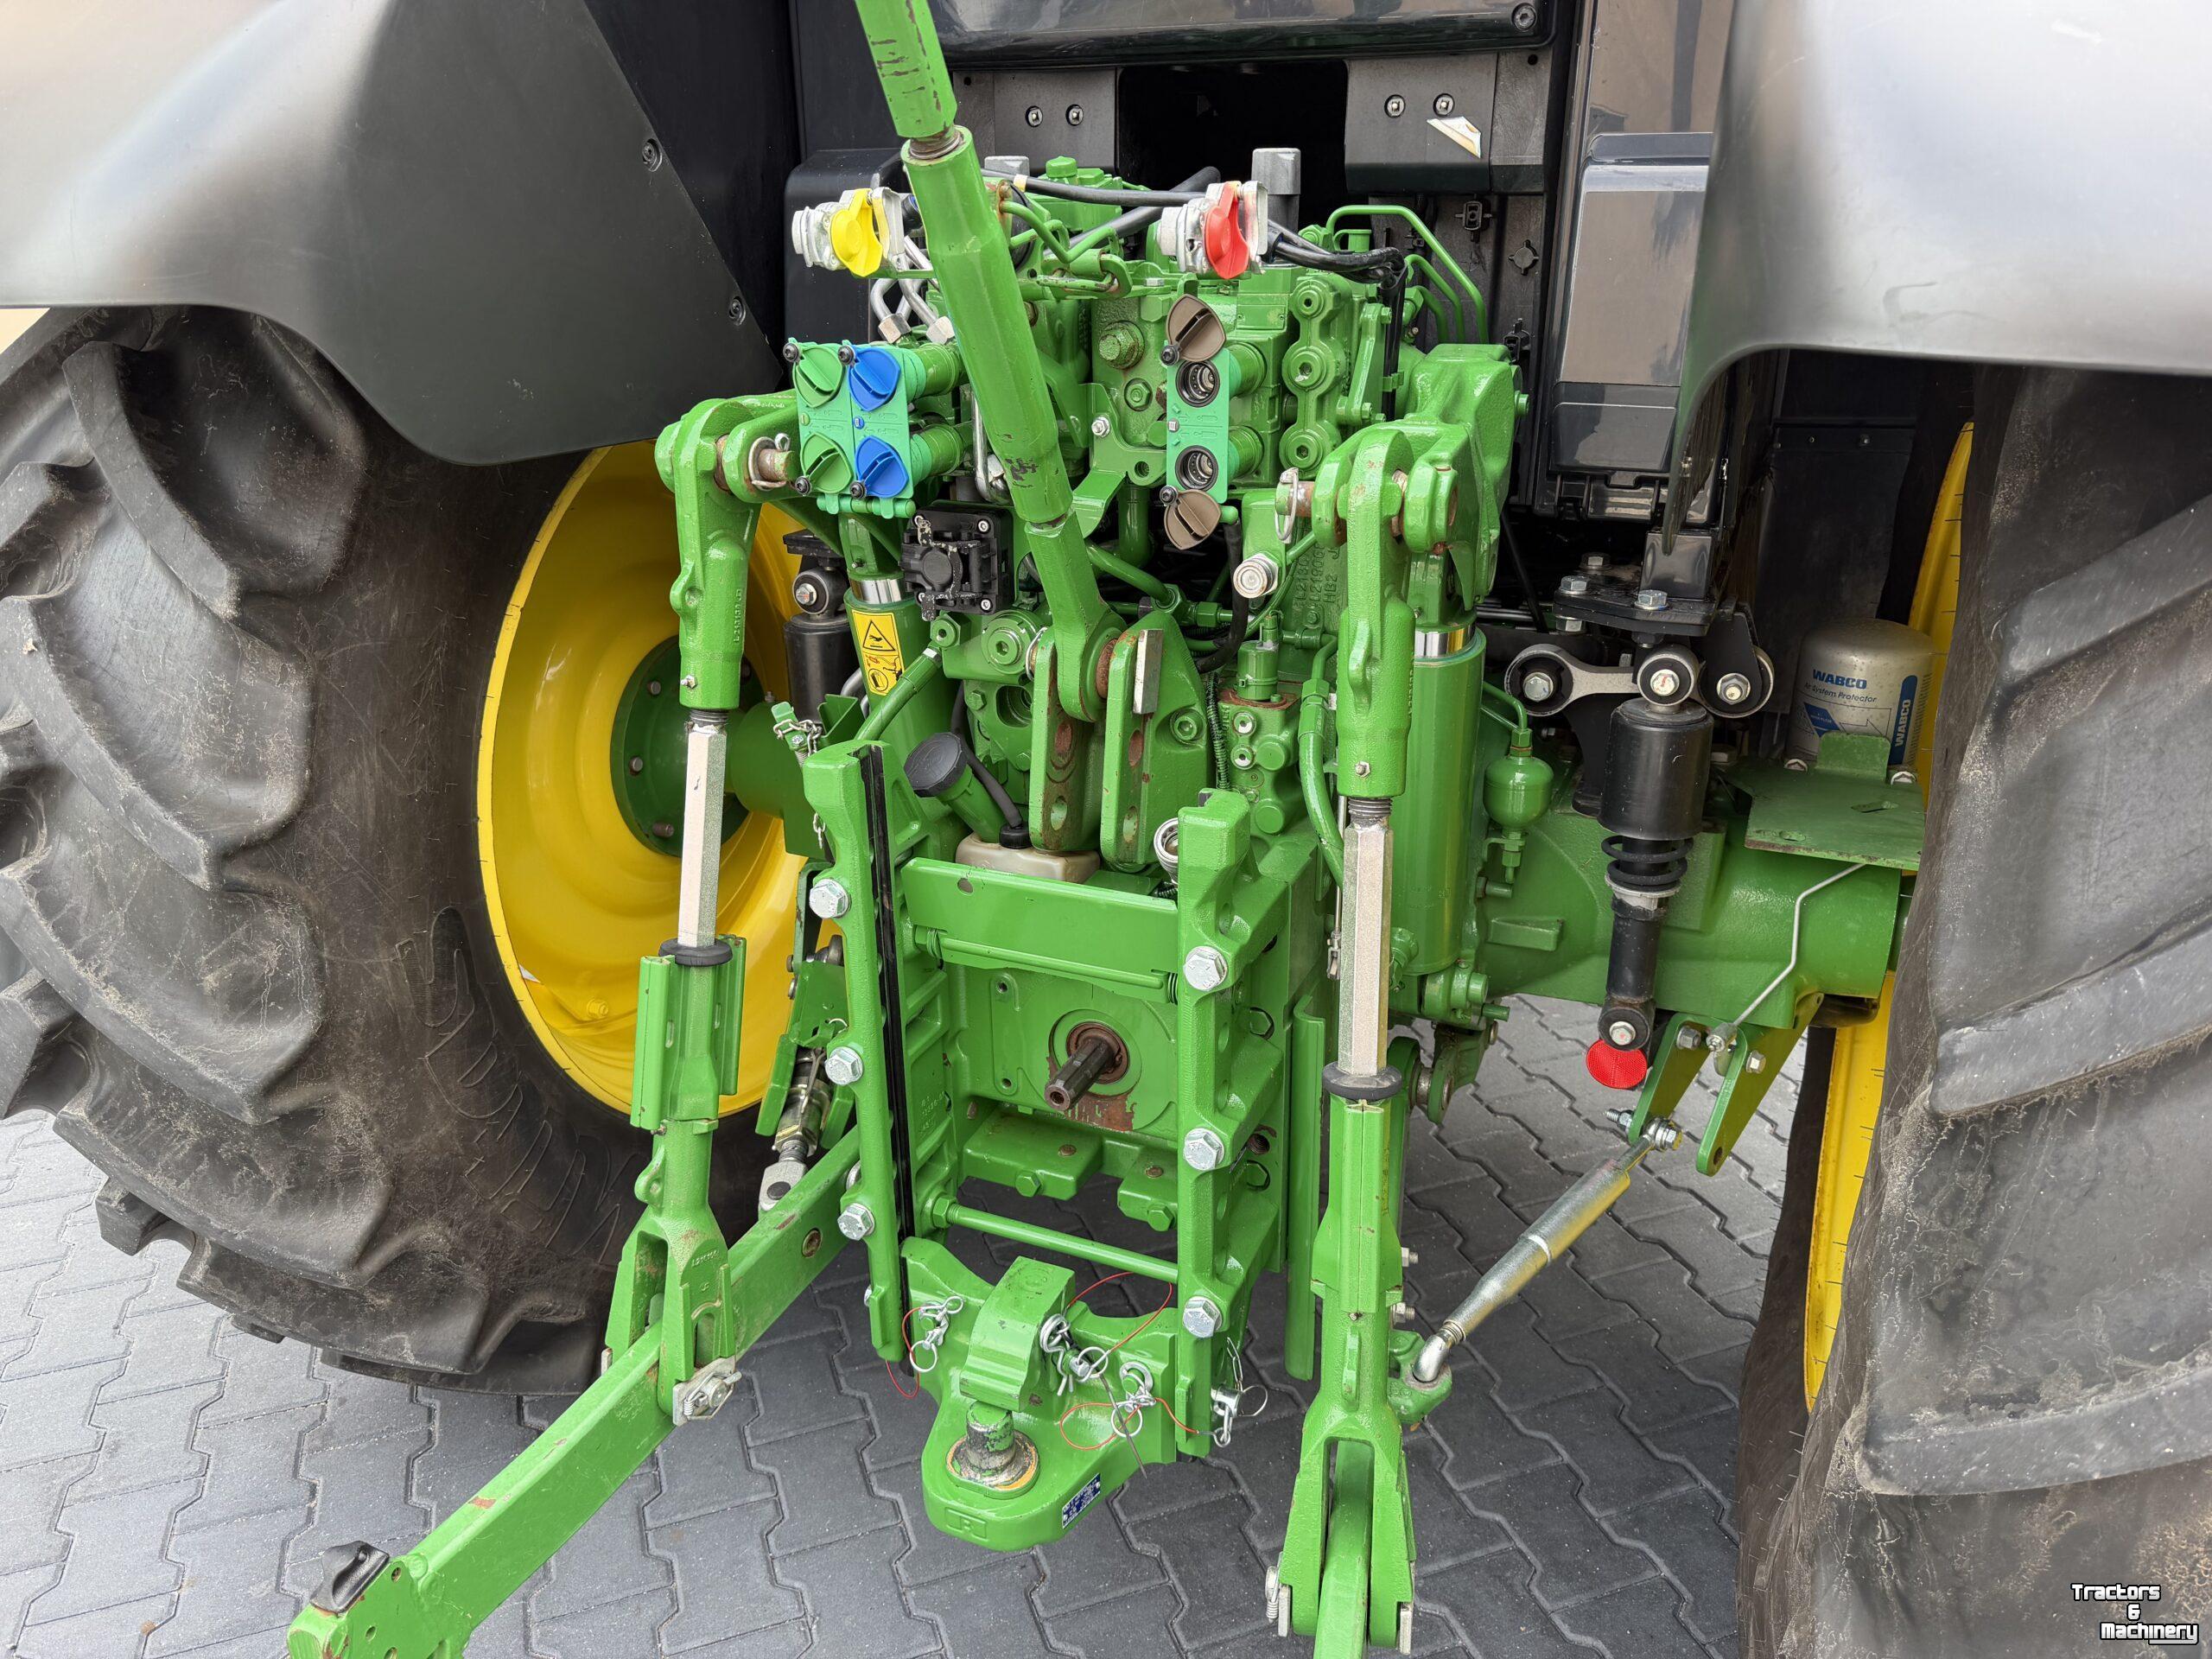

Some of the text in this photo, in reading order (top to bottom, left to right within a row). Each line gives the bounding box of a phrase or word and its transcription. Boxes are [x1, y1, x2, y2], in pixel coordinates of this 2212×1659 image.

[1813, 669, 1867, 690] WABCO
[1812, 685, 1836, 697] System
[1838, 691, 1878, 702] Protector
[1895, 699, 1910, 747] WABCO
